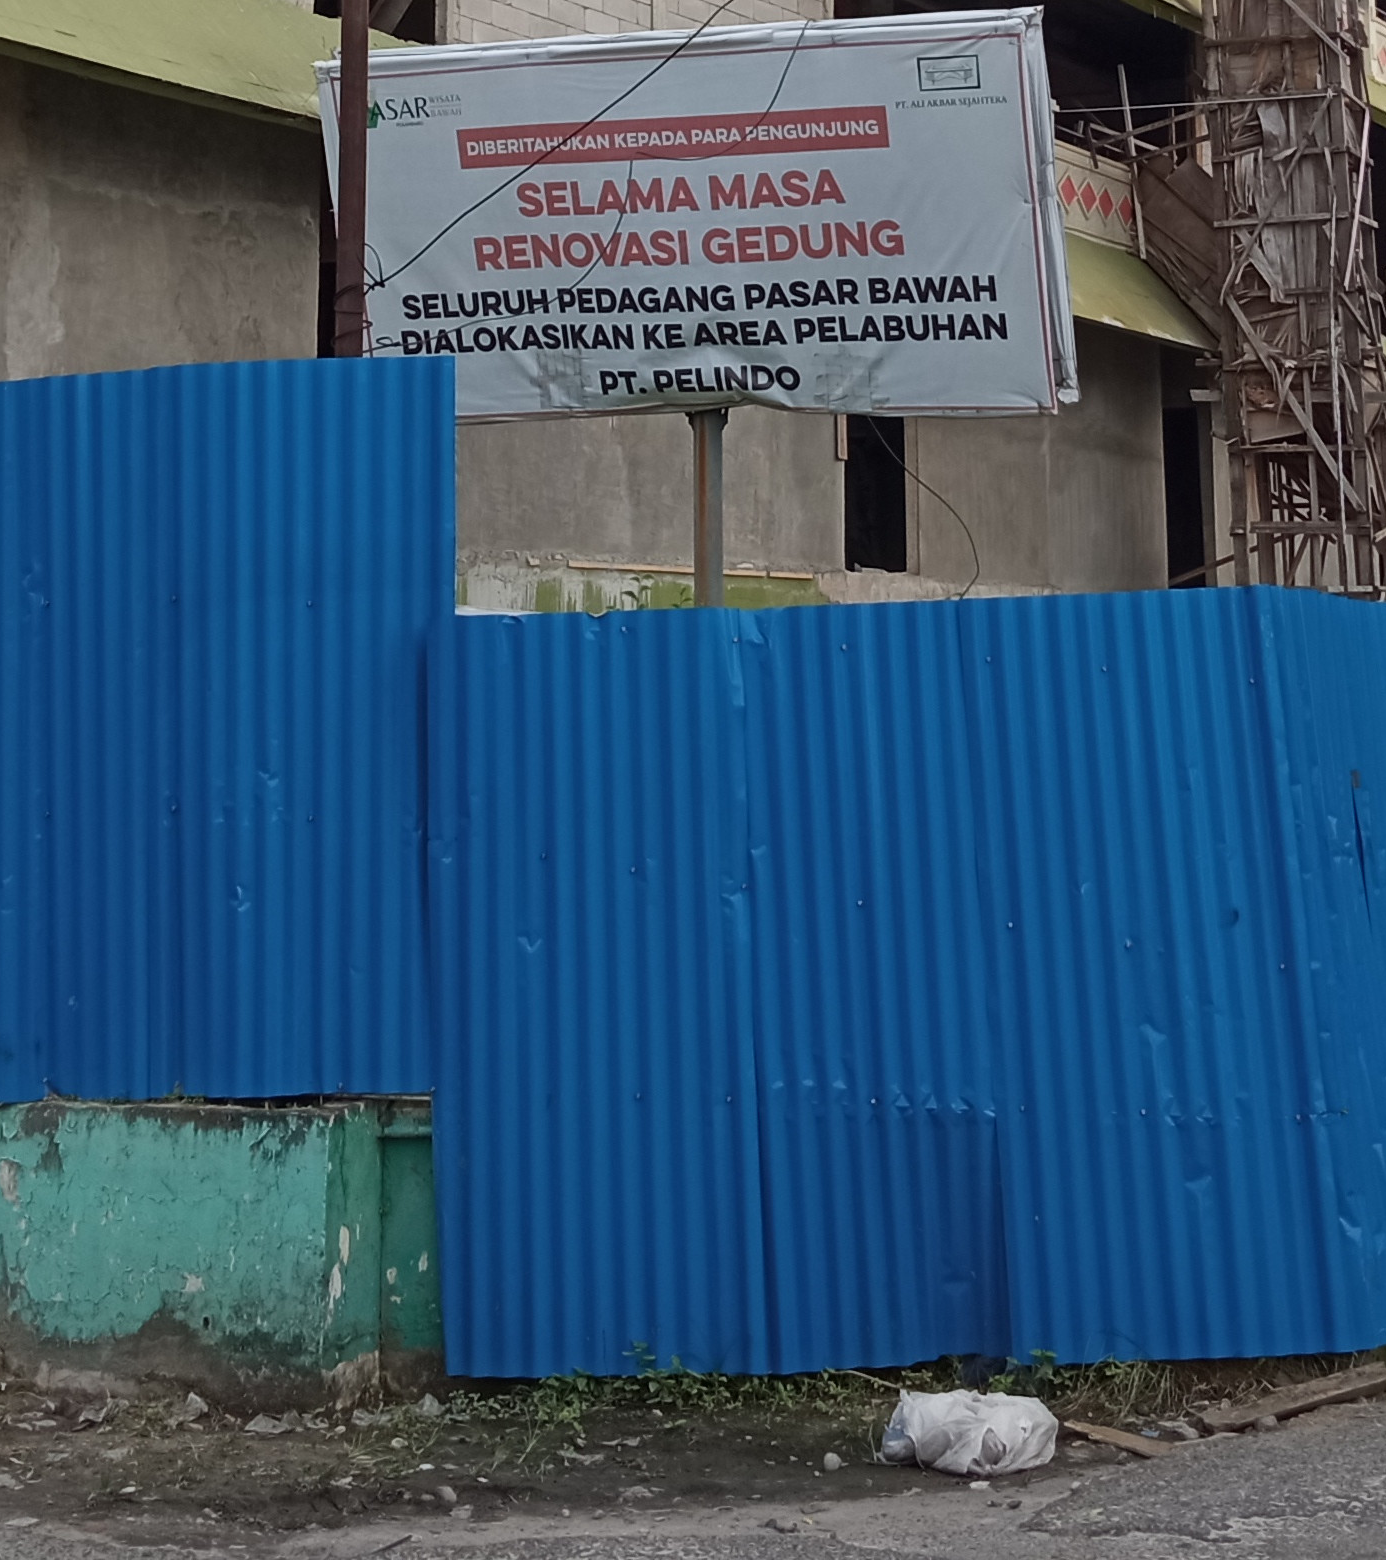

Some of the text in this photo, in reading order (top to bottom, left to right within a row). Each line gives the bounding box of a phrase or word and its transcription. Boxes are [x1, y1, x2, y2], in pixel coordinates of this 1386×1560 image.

[370, 96, 430, 120] ASAR
[895, 95, 1007, 109] PT. ALI AKBAR SEJAHTERA
[466, 119, 880, 157] DIBERITAHUKAN KEPADA PARA PENGUNJUNG
[516, 168, 845, 217] SELAMA MASA
[473, 219, 906, 271] RENOVASI GEDUNG
[401, 274, 998, 320] SELURUH PEDAGANG PASAR BAWAH
[400, 312, 1009, 356] DIALOKASIKAN KE AREA PELABUHAN
[598, 365, 802, 396] PT. PELINDO
